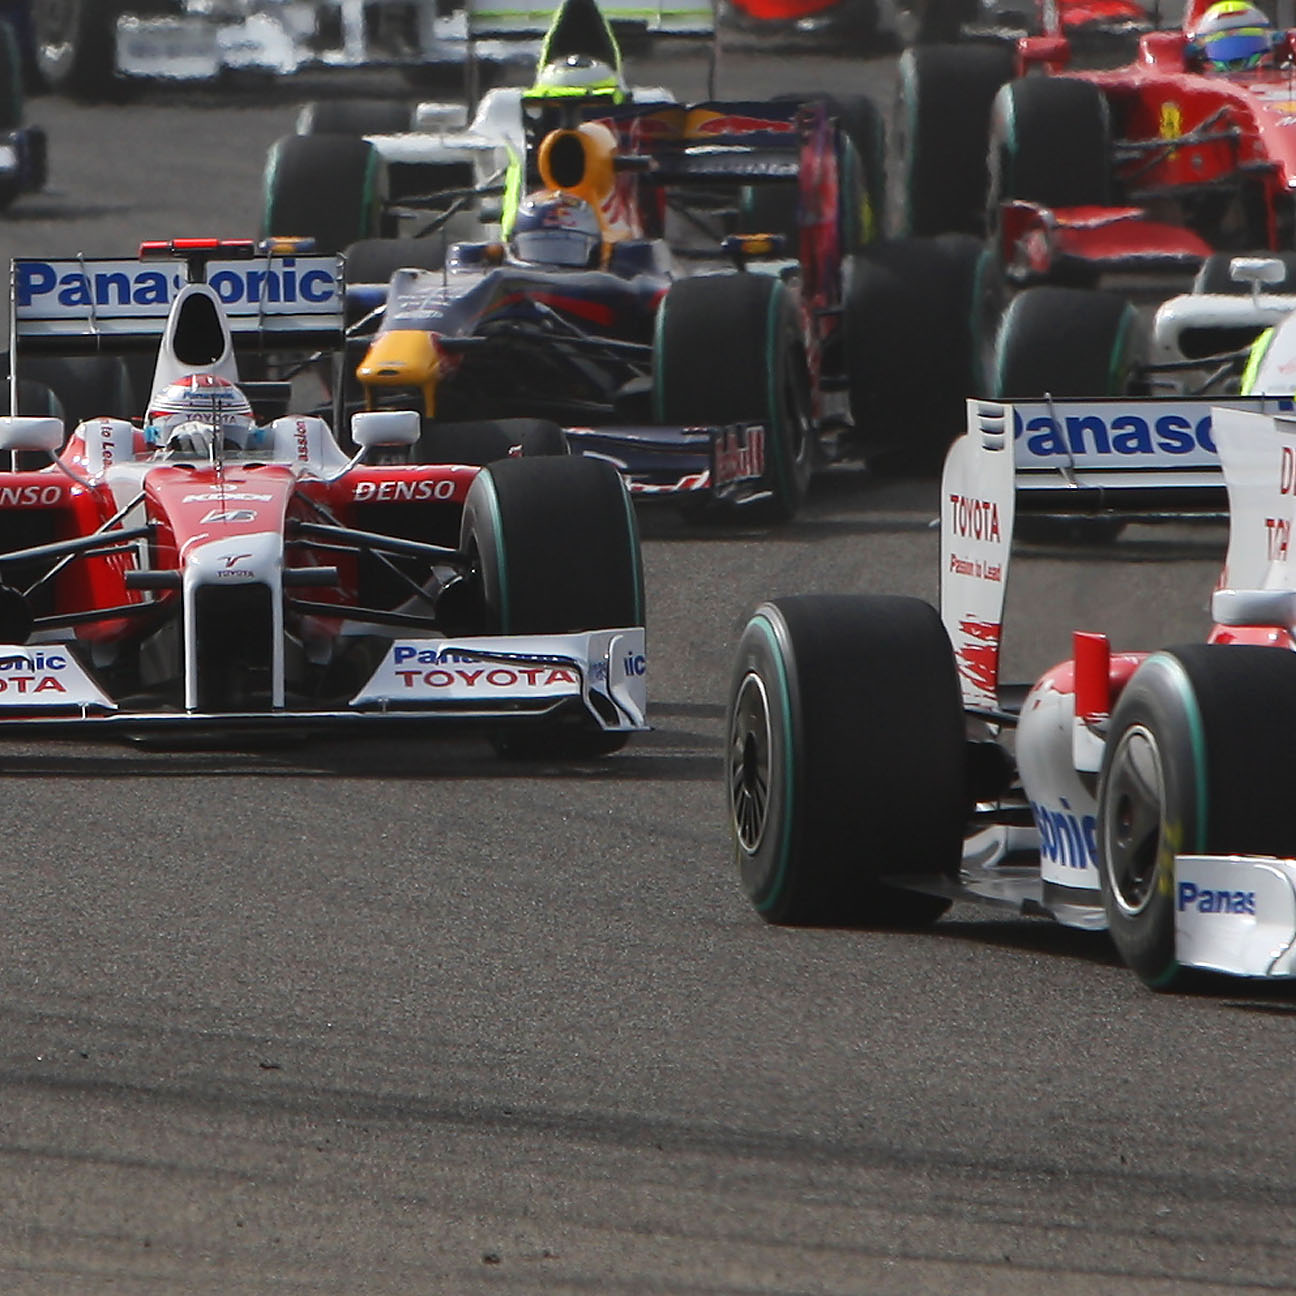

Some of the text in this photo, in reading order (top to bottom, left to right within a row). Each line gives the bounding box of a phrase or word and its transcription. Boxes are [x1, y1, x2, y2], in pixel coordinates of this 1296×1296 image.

[15, 258, 337, 307] Panaonic
[294, 420, 309, 462] assion
[353, 480, 456, 501] DENSO
[950, 493, 1001, 544] TOYOTA
[395, 668, 577, 688] TOYOTA
